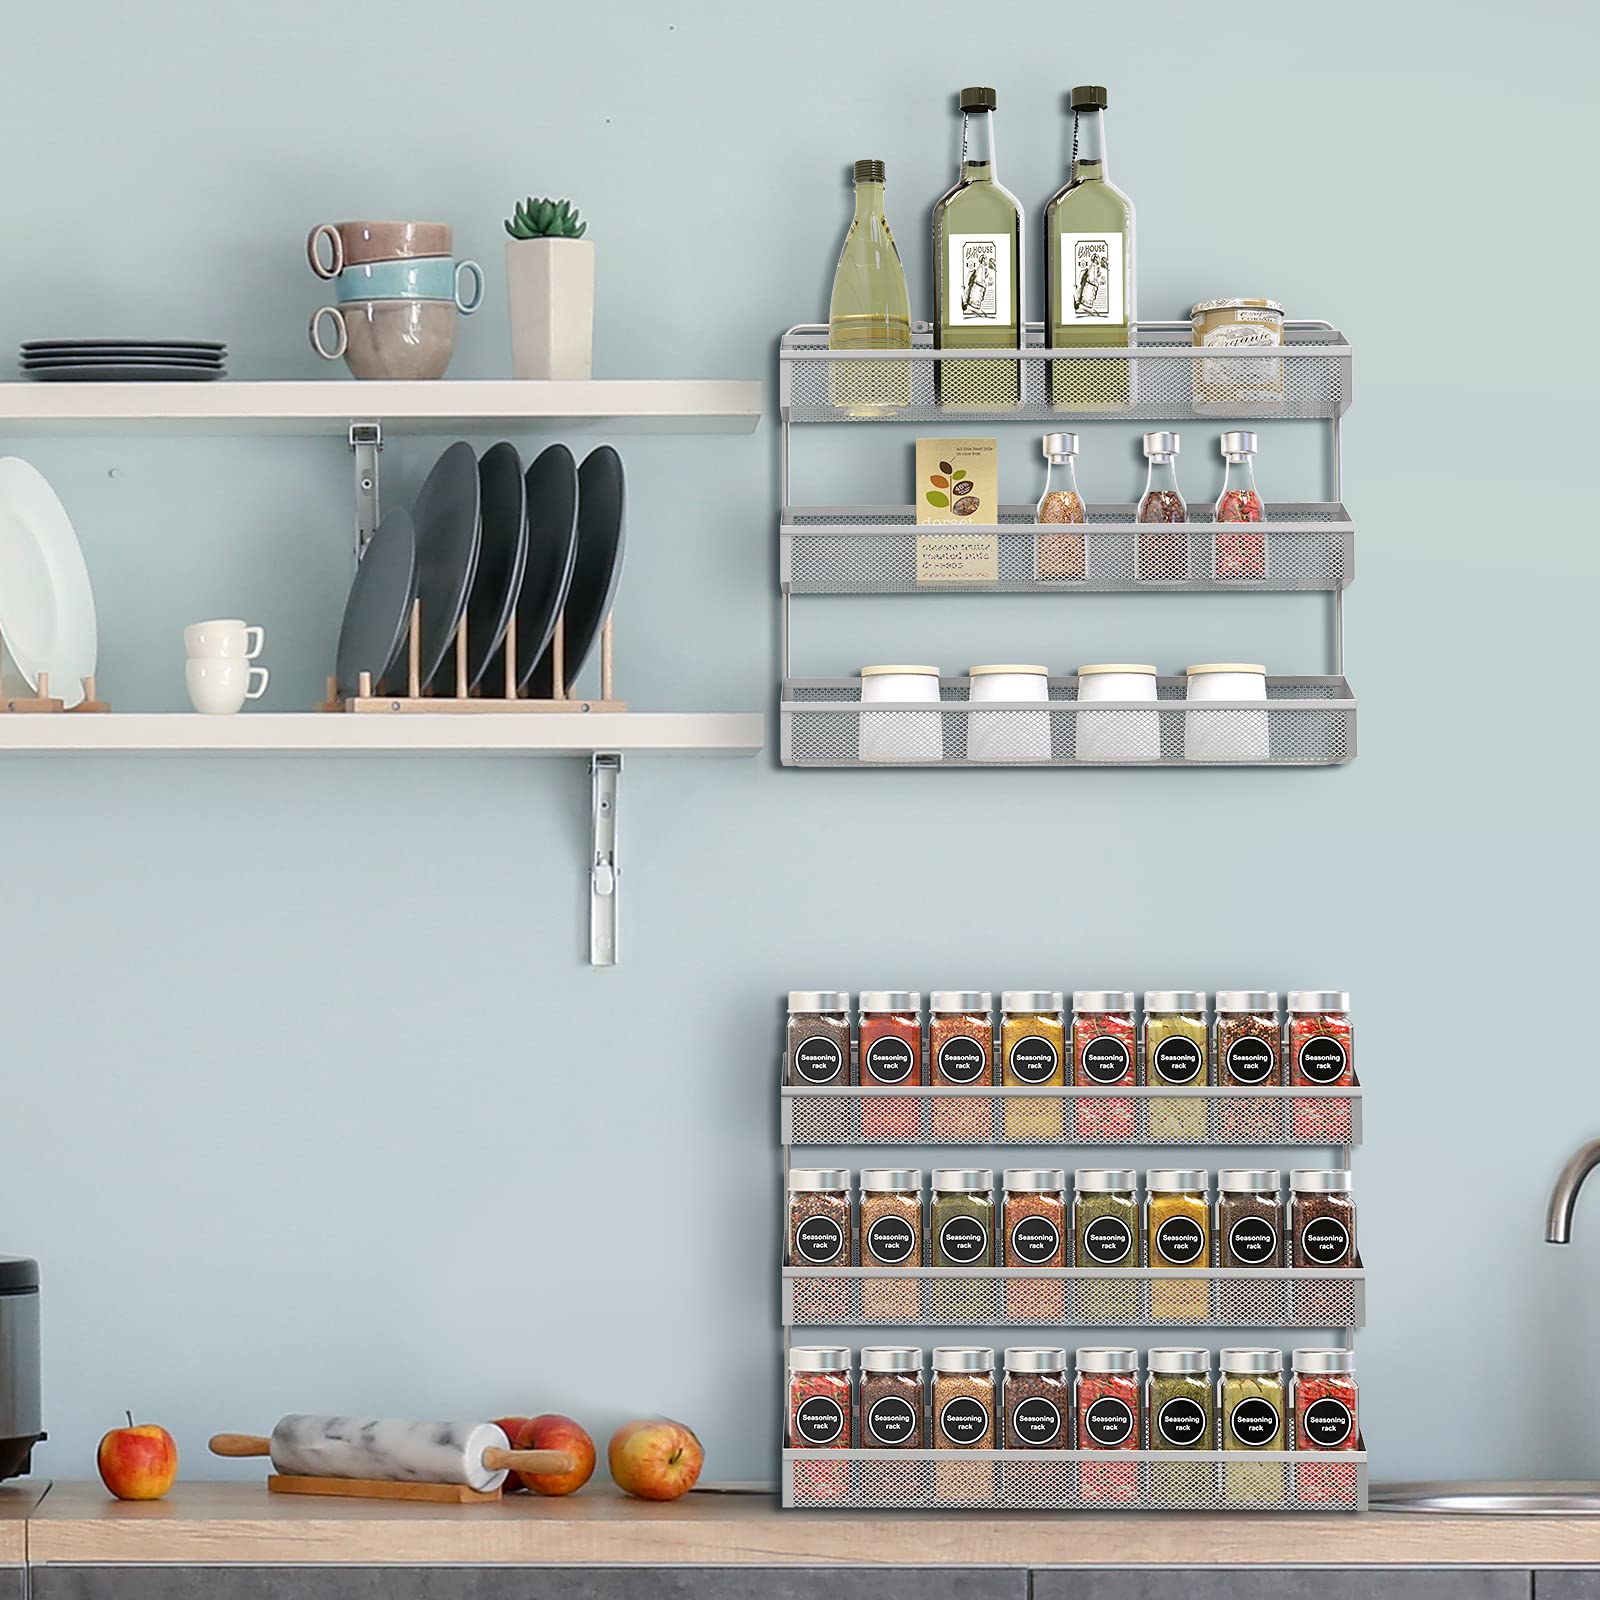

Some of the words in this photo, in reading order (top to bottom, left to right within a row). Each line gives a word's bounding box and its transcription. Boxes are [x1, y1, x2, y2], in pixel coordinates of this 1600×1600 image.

[972, 245, 993, 253] HOUSE
[1085, 244, 1106, 253] HOUSE
[800, 1054, 836, 1063] Seasoning
[872, 1054, 908, 1063] Seasoning
[944, 1054, 980, 1063] Seasoning
[1016, 1054, 1052, 1063] Seasoning
[1088, 1054, 1124, 1063] Seasoning
[1160, 1055, 1196, 1064] Seasoning
[1232, 1054, 1268, 1063] Seasoning
[1305, 1055, 1341, 1064] Seasoning
[811, 1061, 827, 1069] rack
[883, 1061, 899, 1069] rack
[955, 1061, 971, 1069] rack
[1027, 1061, 1043, 1069] rack
[1099, 1061, 1115, 1069] rack
[1171, 1062, 1187, 1070] rack
[1243, 1061, 1259, 1069] rack
[1316, 1062, 1332, 1070] rack
[801, 1234, 837, 1243] Seasoning
[873, 1234, 909, 1243] Seasoning
[945, 1234, 981, 1243] Seasoning
[1018, 1234, 1054, 1243] Seasoning
[1090, 1235, 1126, 1244] Seasoning
[1162, 1235, 1198, 1244] Seasoning
[1235, 1235, 1271, 1244] Seasoning
[1308, 1235, 1344, 1244] Seasoning
[812, 1241, 828, 1249] rack
[884, 1241, 900, 1249] rack
[956, 1241, 972, 1249] rack
[1029, 1241, 1045, 1249] rack
[1101, 1242, 1117, 1250] rack
[1173, 1242, 1189, 1250] rack
[1246, 1242, 1262, 1250] rack
[1319, 1242, 1335, 1250] rack
[802, 1415, 838, 1424] Seasoning
[874, 1415, 910, 1424] Seasoning
[946, 1415, 982, 1424] Seasoning
[1019, 1416, 1055, 1425] Seasoning
[1091, 1416, 1127, 1425] Seasoning
[1164, 1416, 1200, 1425] Seasoning
[1237, 1417, 1273, 1426] Seasoning
[1310, 1417, 1346, 1426] Seasoning
[813, 1422, 829, 1430] rack
[885, 1422, 901, 1430] rack
[957, 1422, 973, 1430] rack
[1030, 1423, 1046, 1431] rack
[1102, 1423, 1118, 1431] rack
[1175, 1423, 1191, 1431] rack
[1248, 1424, 1264, 1432] rack
[1321, 1424, 1337, 1432] rack
